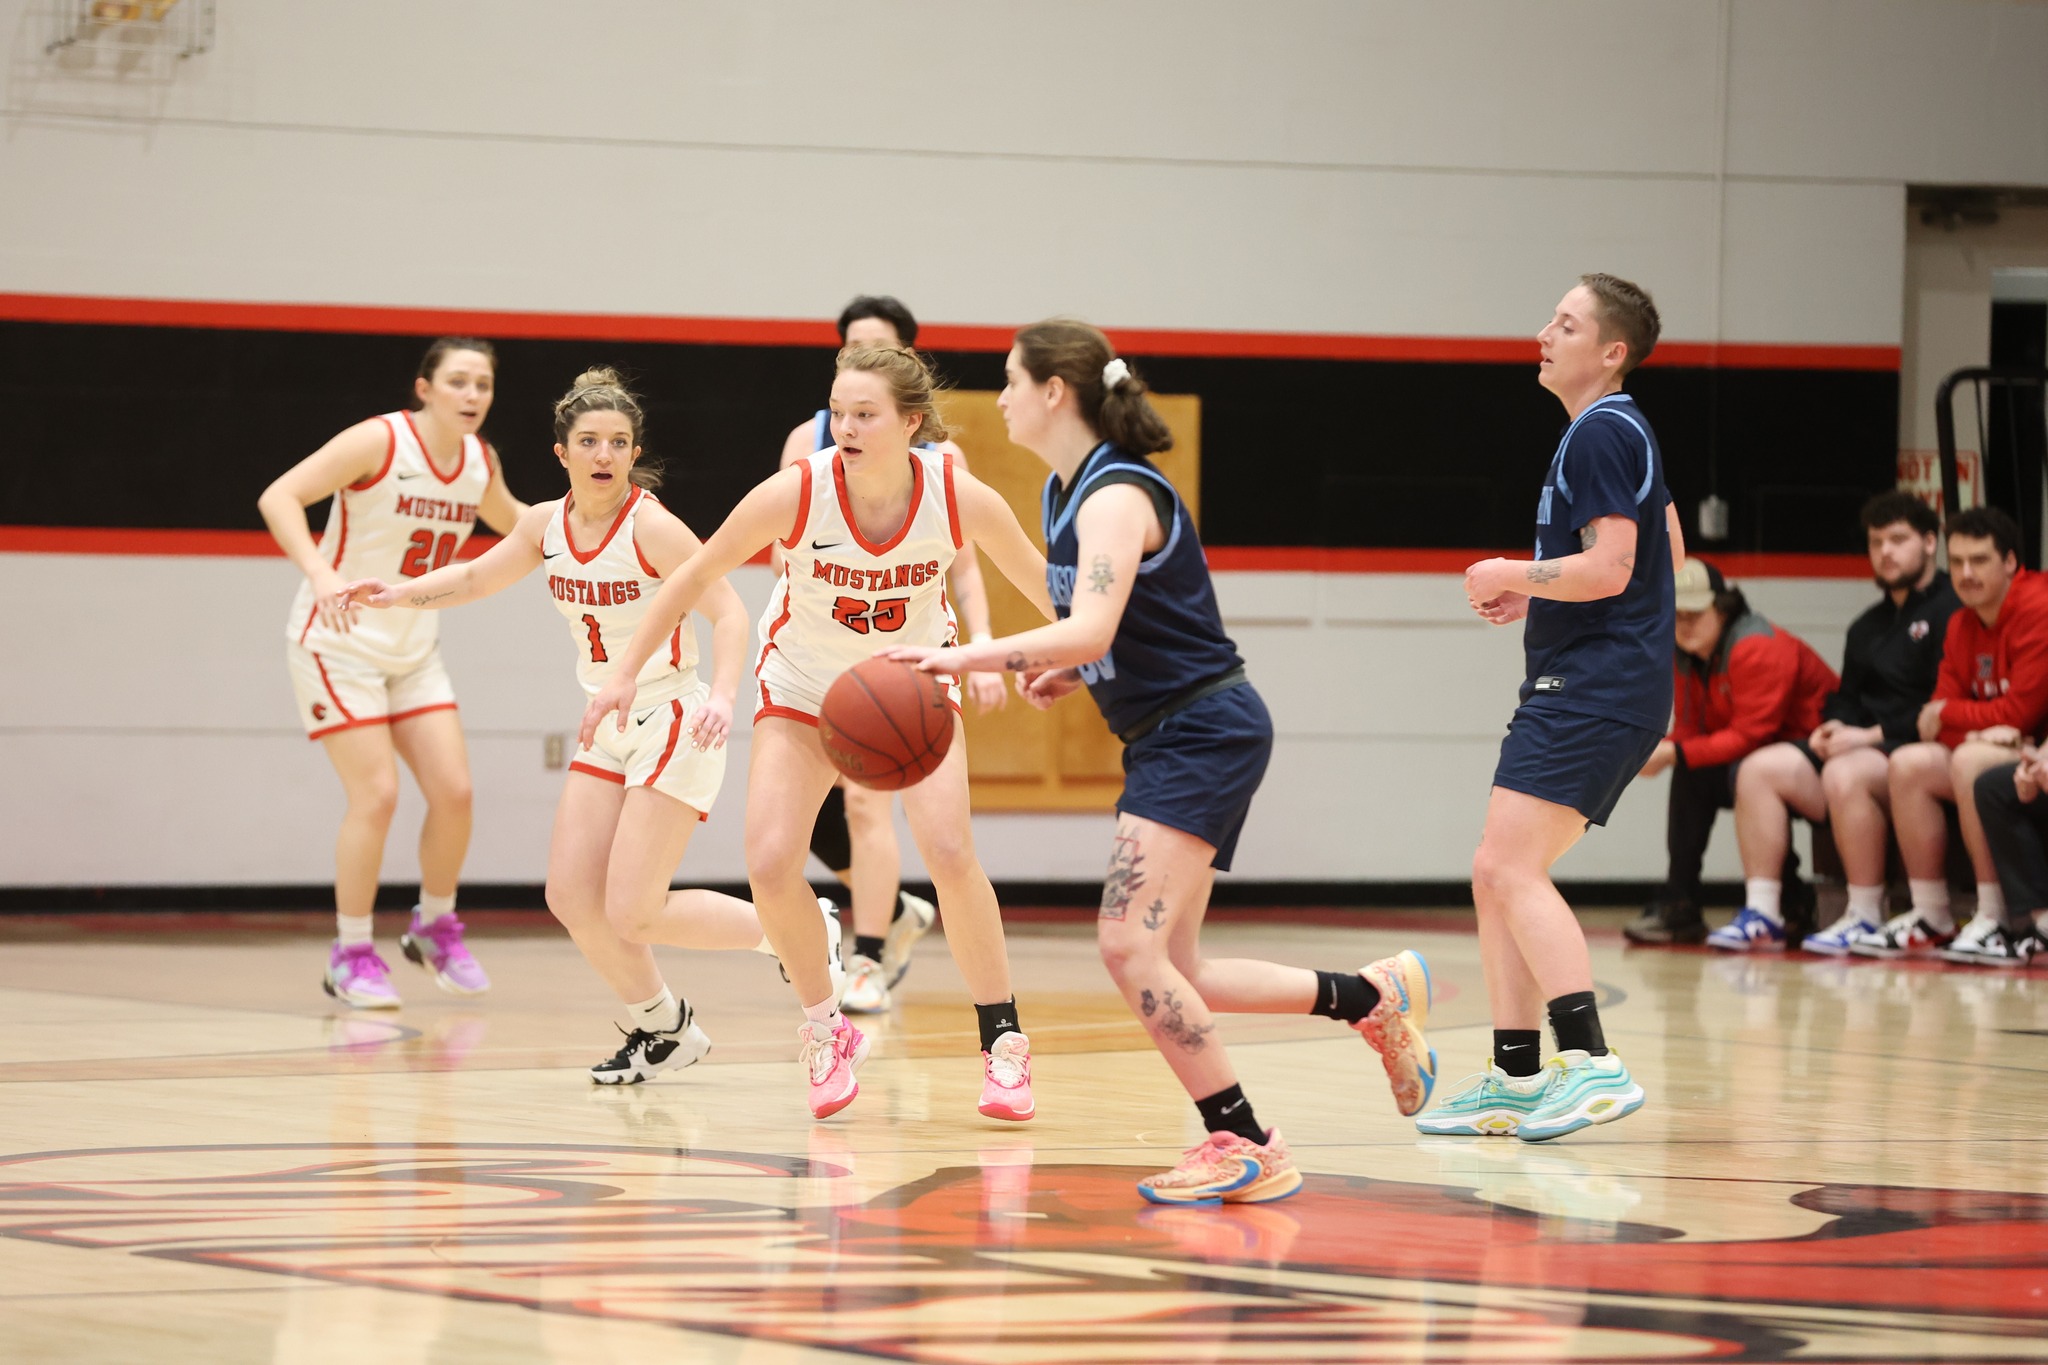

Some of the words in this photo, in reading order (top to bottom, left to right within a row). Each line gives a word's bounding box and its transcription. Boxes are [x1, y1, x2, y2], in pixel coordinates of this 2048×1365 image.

[399, 529, 457, 578] 20
[812, 558, 939, 591] MUSTANGS
[581, 613, 608, 663] 1
